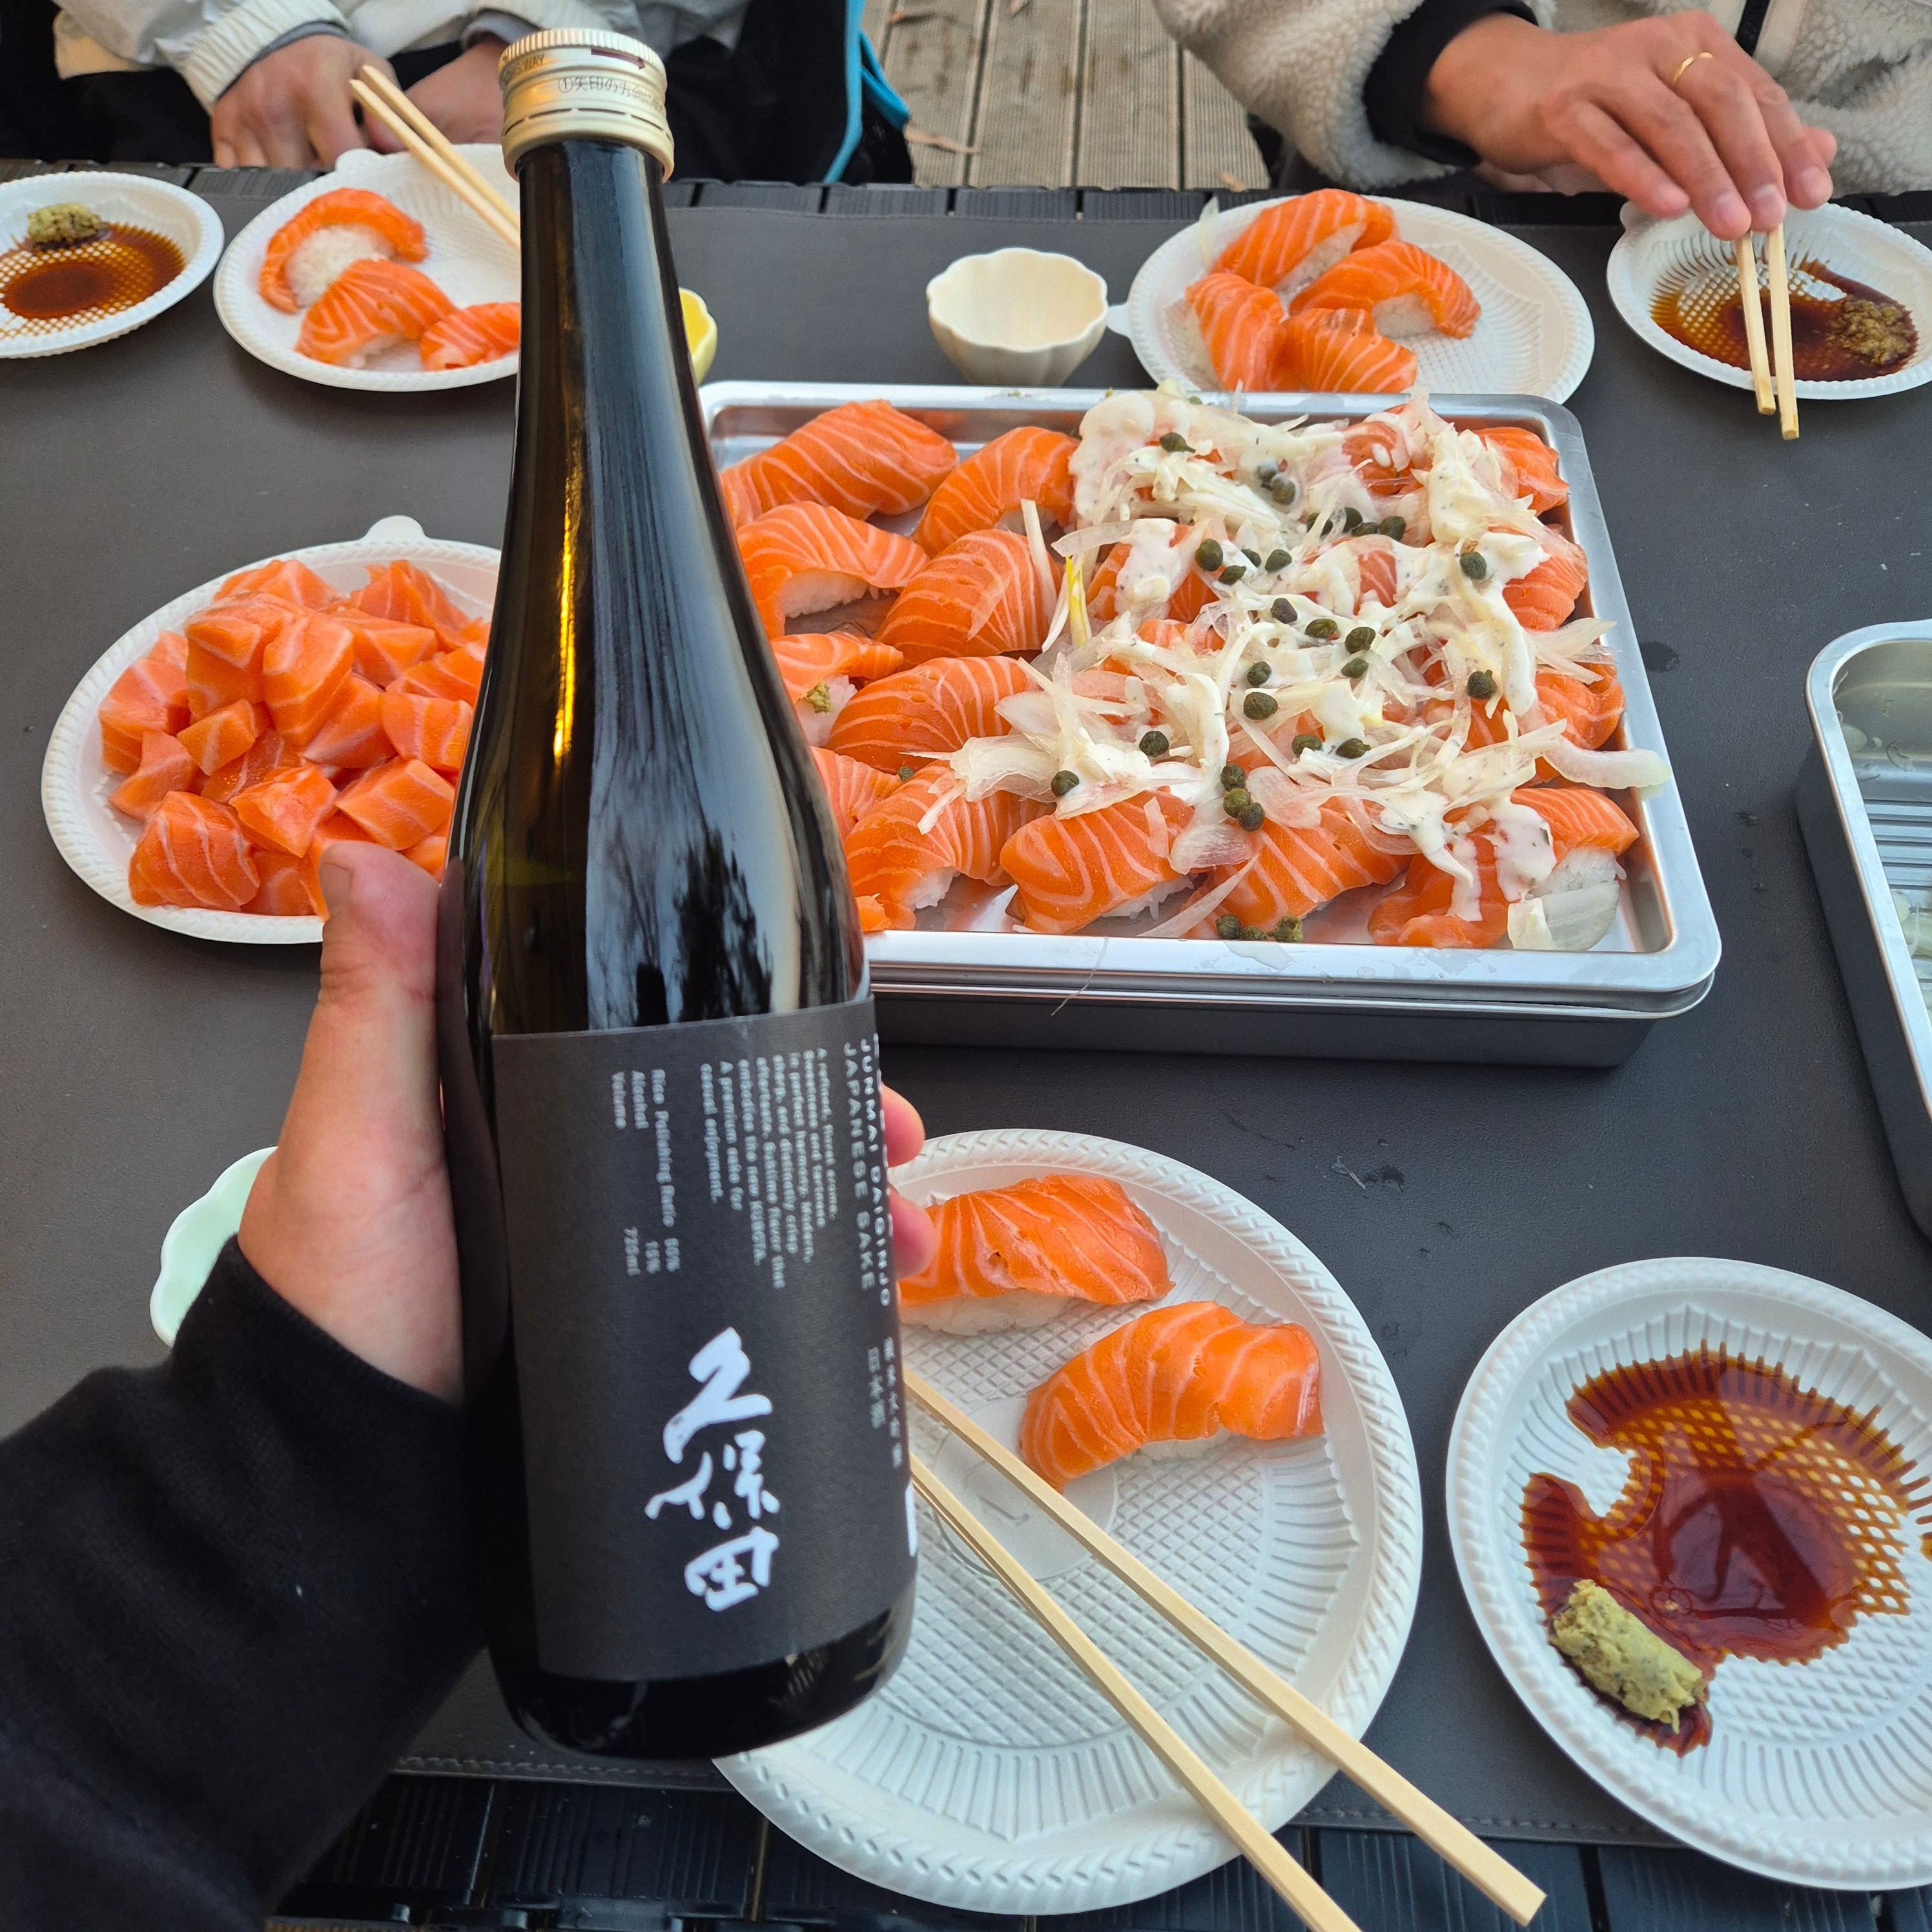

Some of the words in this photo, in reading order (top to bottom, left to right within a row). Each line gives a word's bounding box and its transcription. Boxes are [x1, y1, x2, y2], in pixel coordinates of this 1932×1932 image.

[790, 1053, 799, 1068] in
[844, 1043, 867, 1197] JAPANESE
[858, 1211, 874, 1288] SAKE
[861, 1040, 878, 1151] JUNMAI
[871, 1166, 890, 1306] DAIGINJO
[646, 1327, 779, 1612] 久保田
